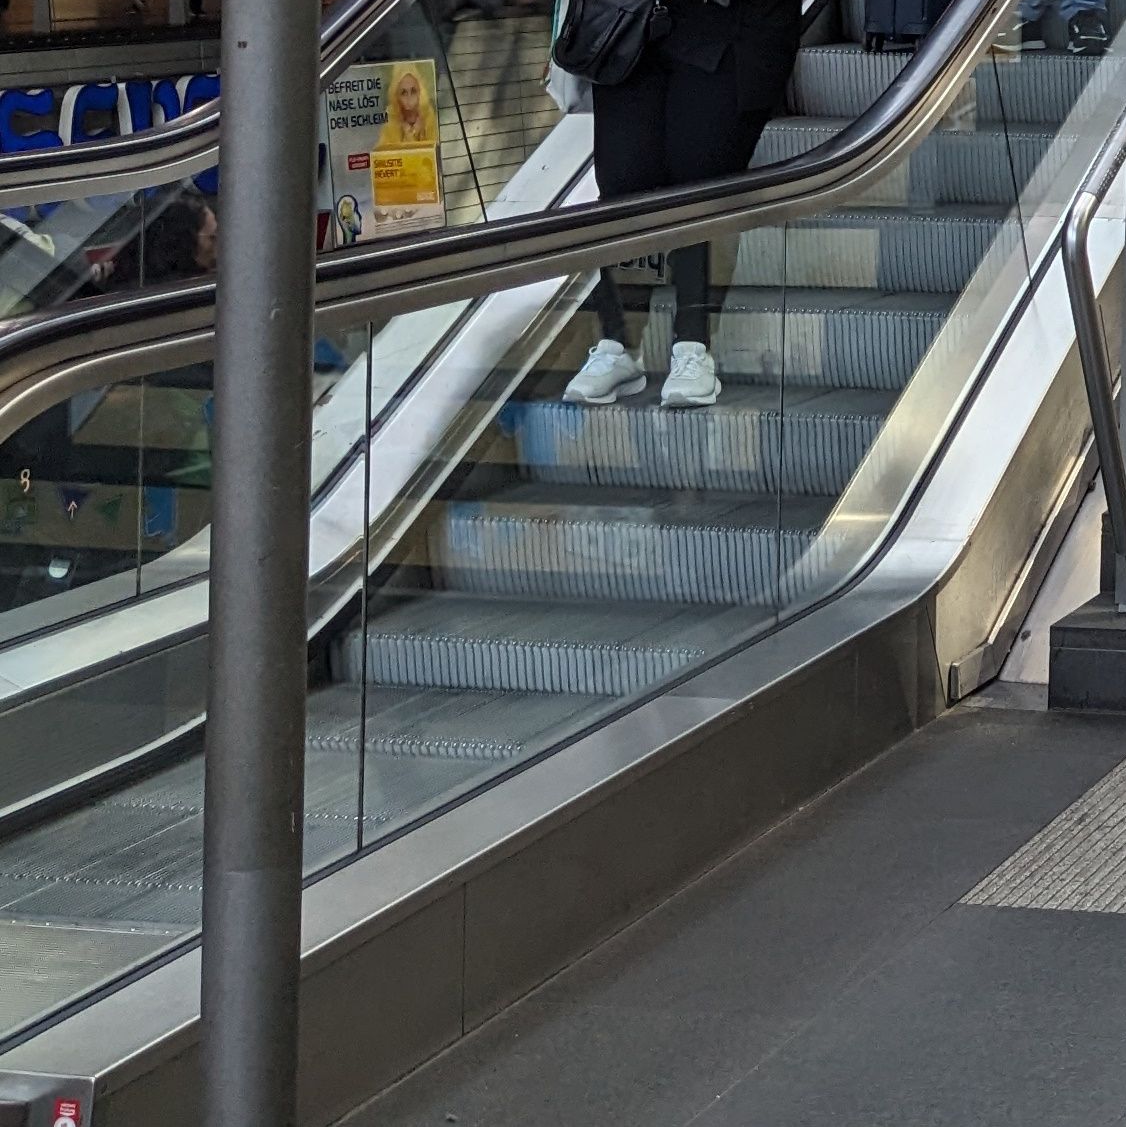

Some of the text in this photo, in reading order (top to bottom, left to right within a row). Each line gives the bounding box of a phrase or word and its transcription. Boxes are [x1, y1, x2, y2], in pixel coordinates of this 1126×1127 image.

[328, 77, 382, 95] BEFREIT DIE
[357, 95, 380, 109] LÖST
[330, 112, 388, 130] DEN SCHLEIM
